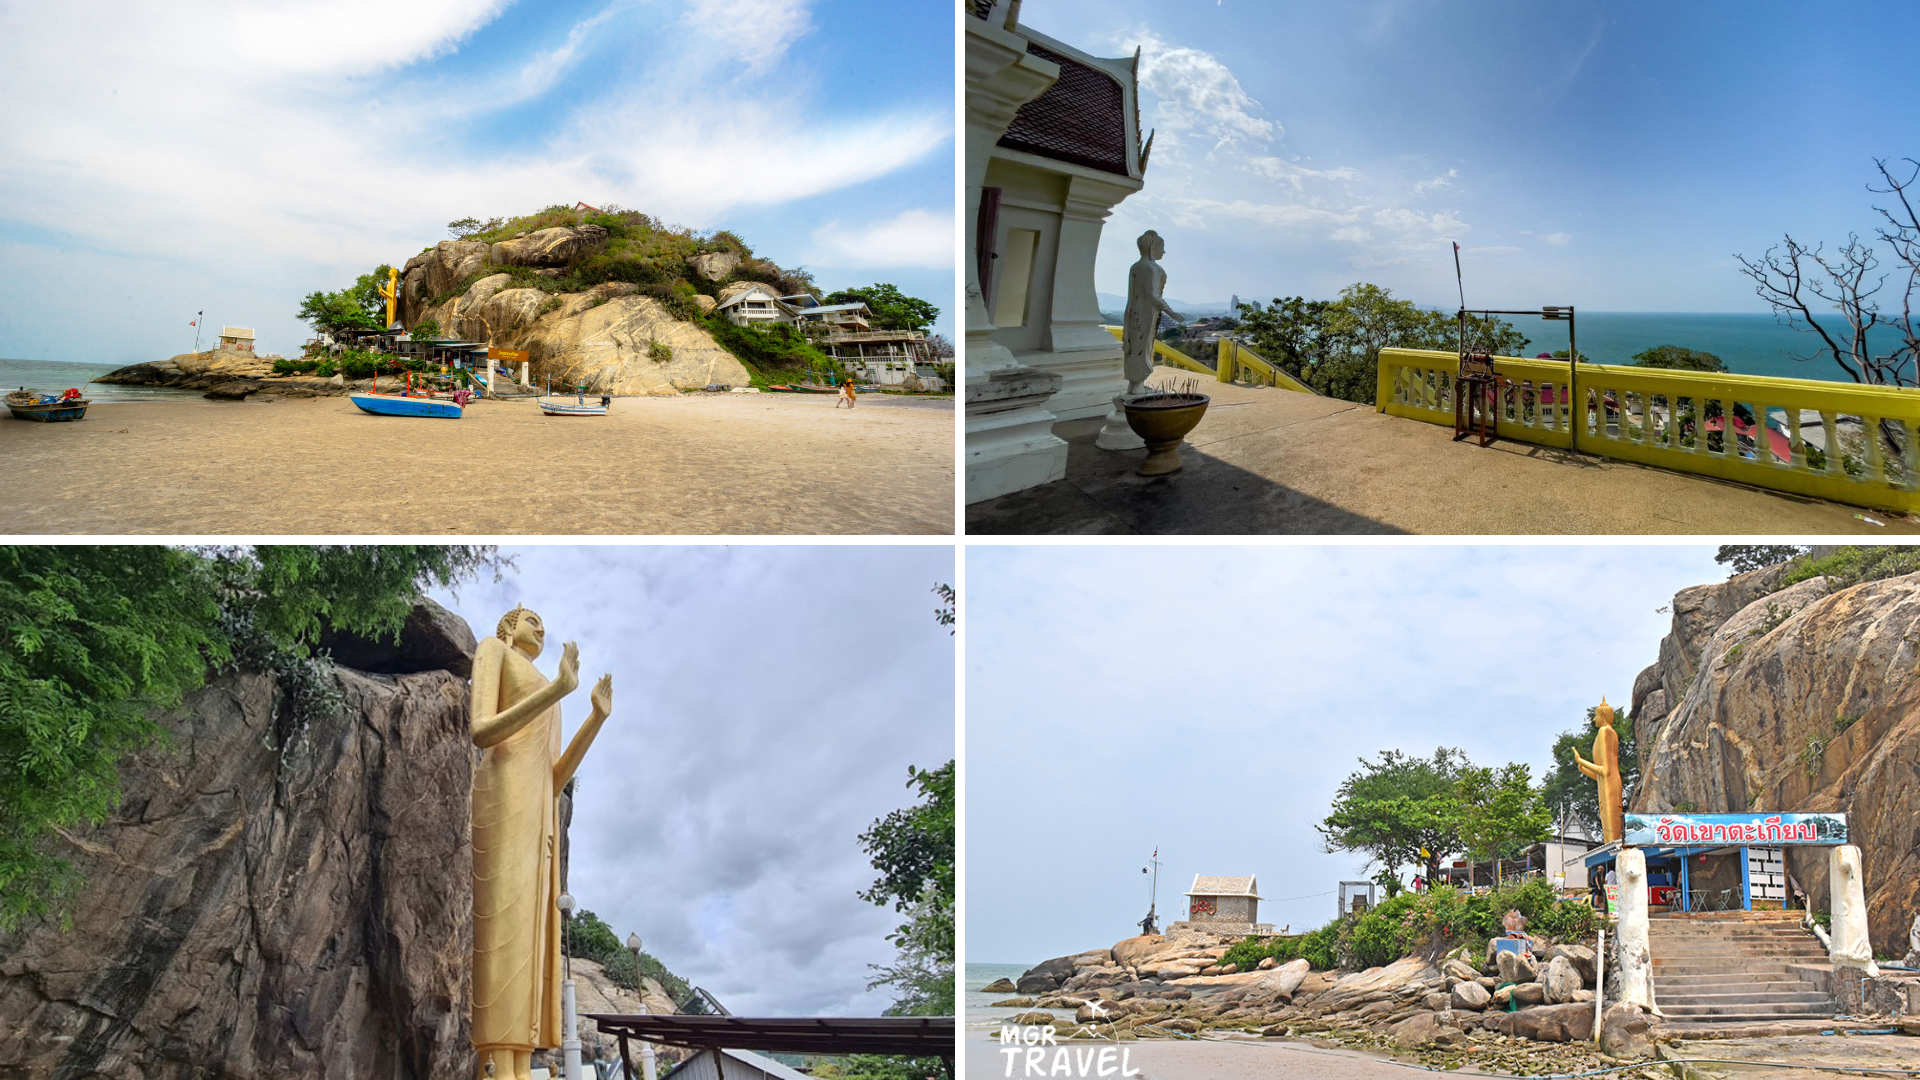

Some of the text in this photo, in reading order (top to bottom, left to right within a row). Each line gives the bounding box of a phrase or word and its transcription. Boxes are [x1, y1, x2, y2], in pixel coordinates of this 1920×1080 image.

[1656, 815, 1818, 842] วัดเขาตะเกียบ
